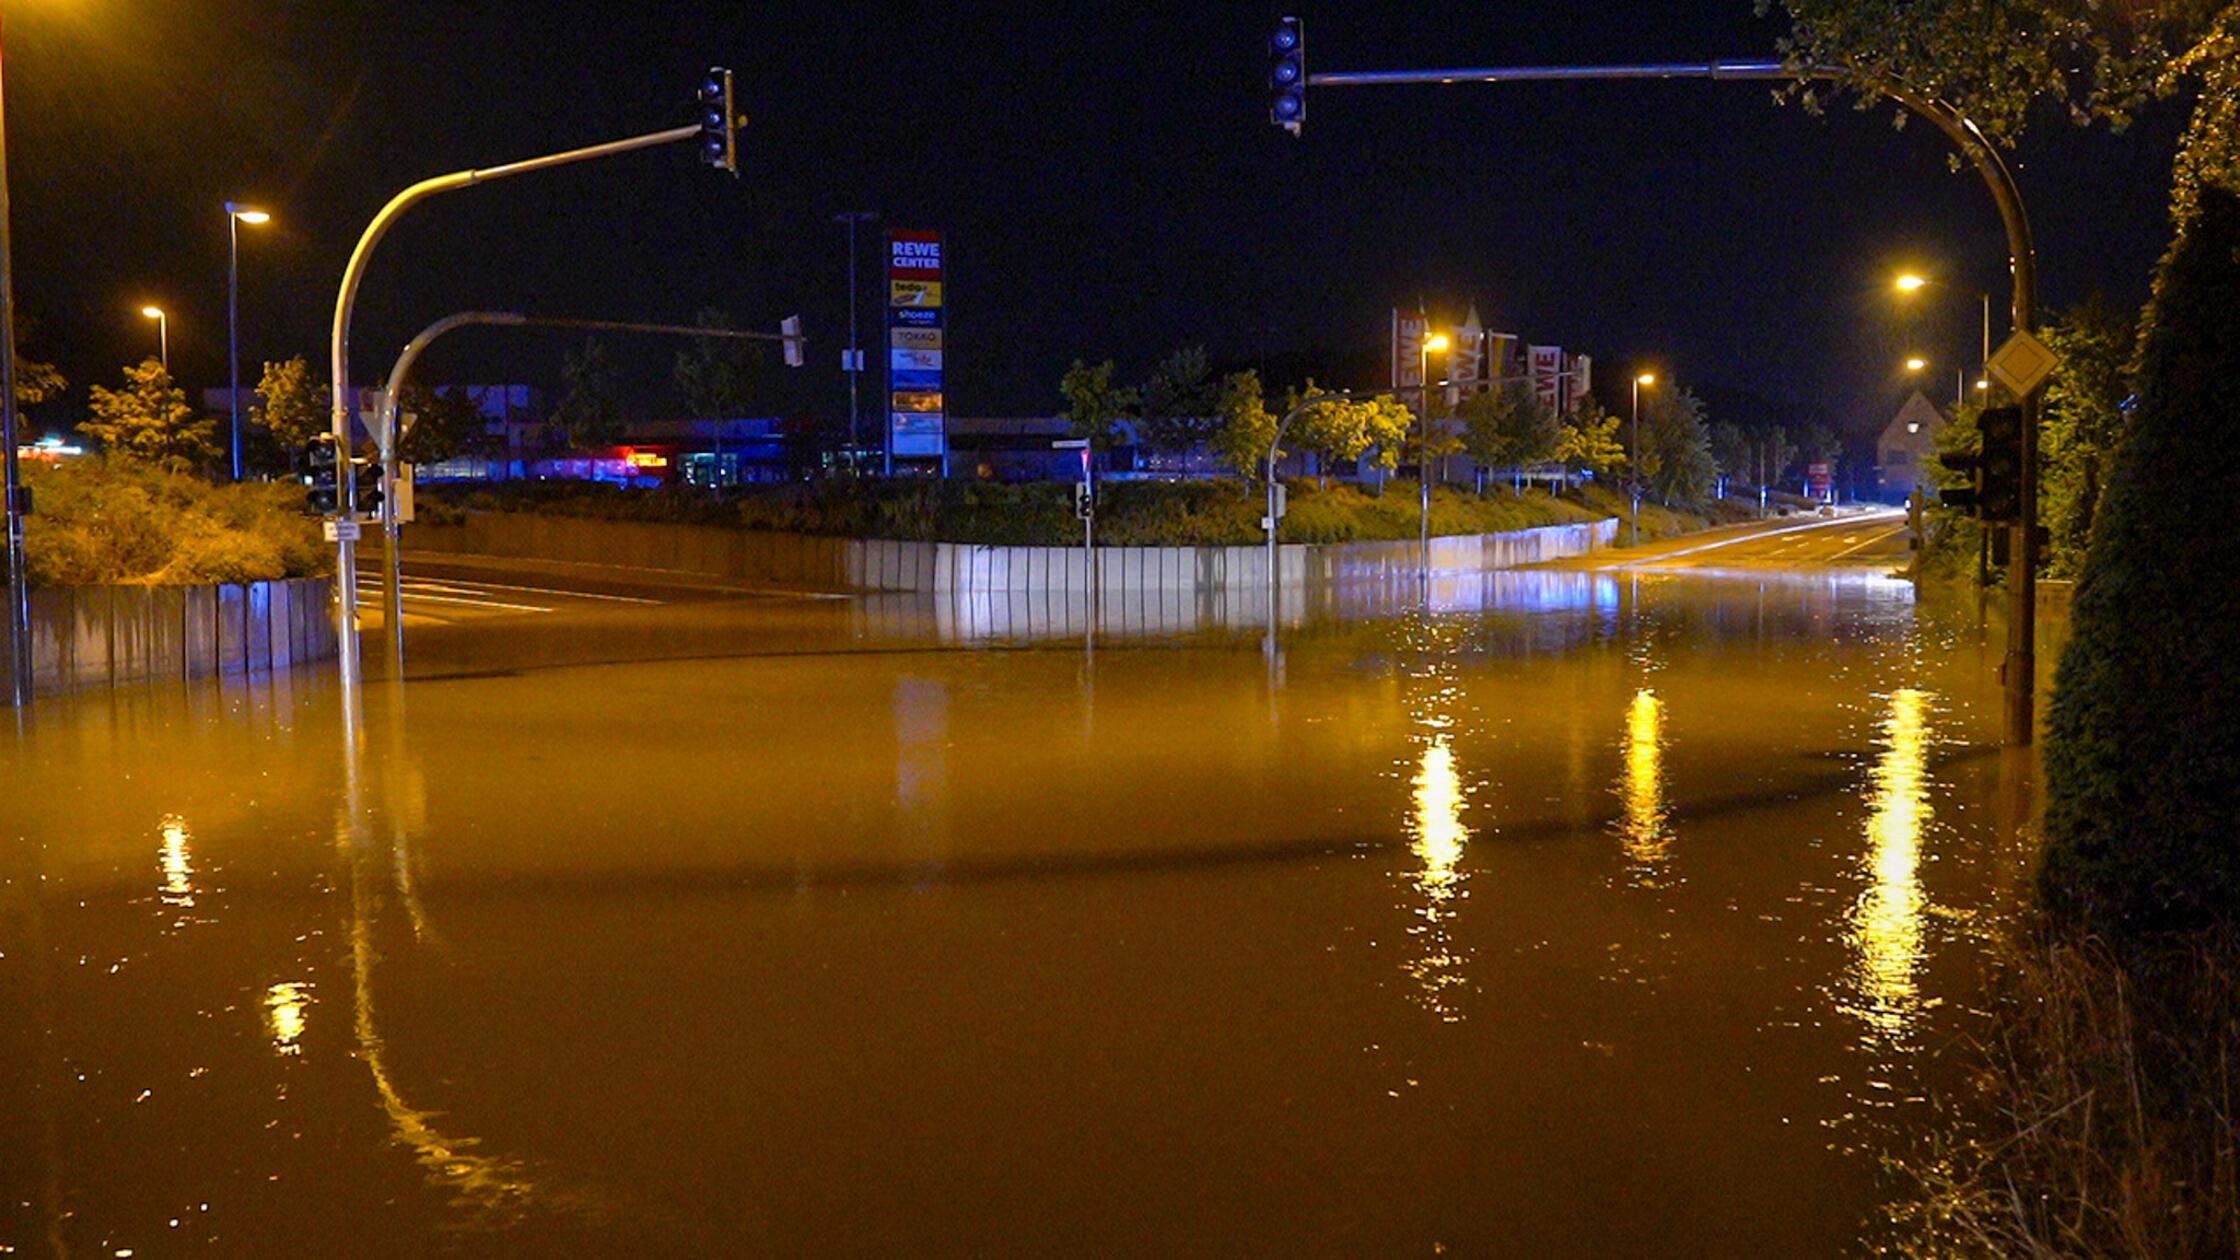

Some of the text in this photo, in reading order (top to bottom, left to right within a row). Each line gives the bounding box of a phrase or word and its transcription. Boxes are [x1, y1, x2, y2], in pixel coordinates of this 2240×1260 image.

[892, 241, 940, 257] REWE
[893, 256, 940, 268] CENTER
[1535, 351, 1556, 408] EWE
